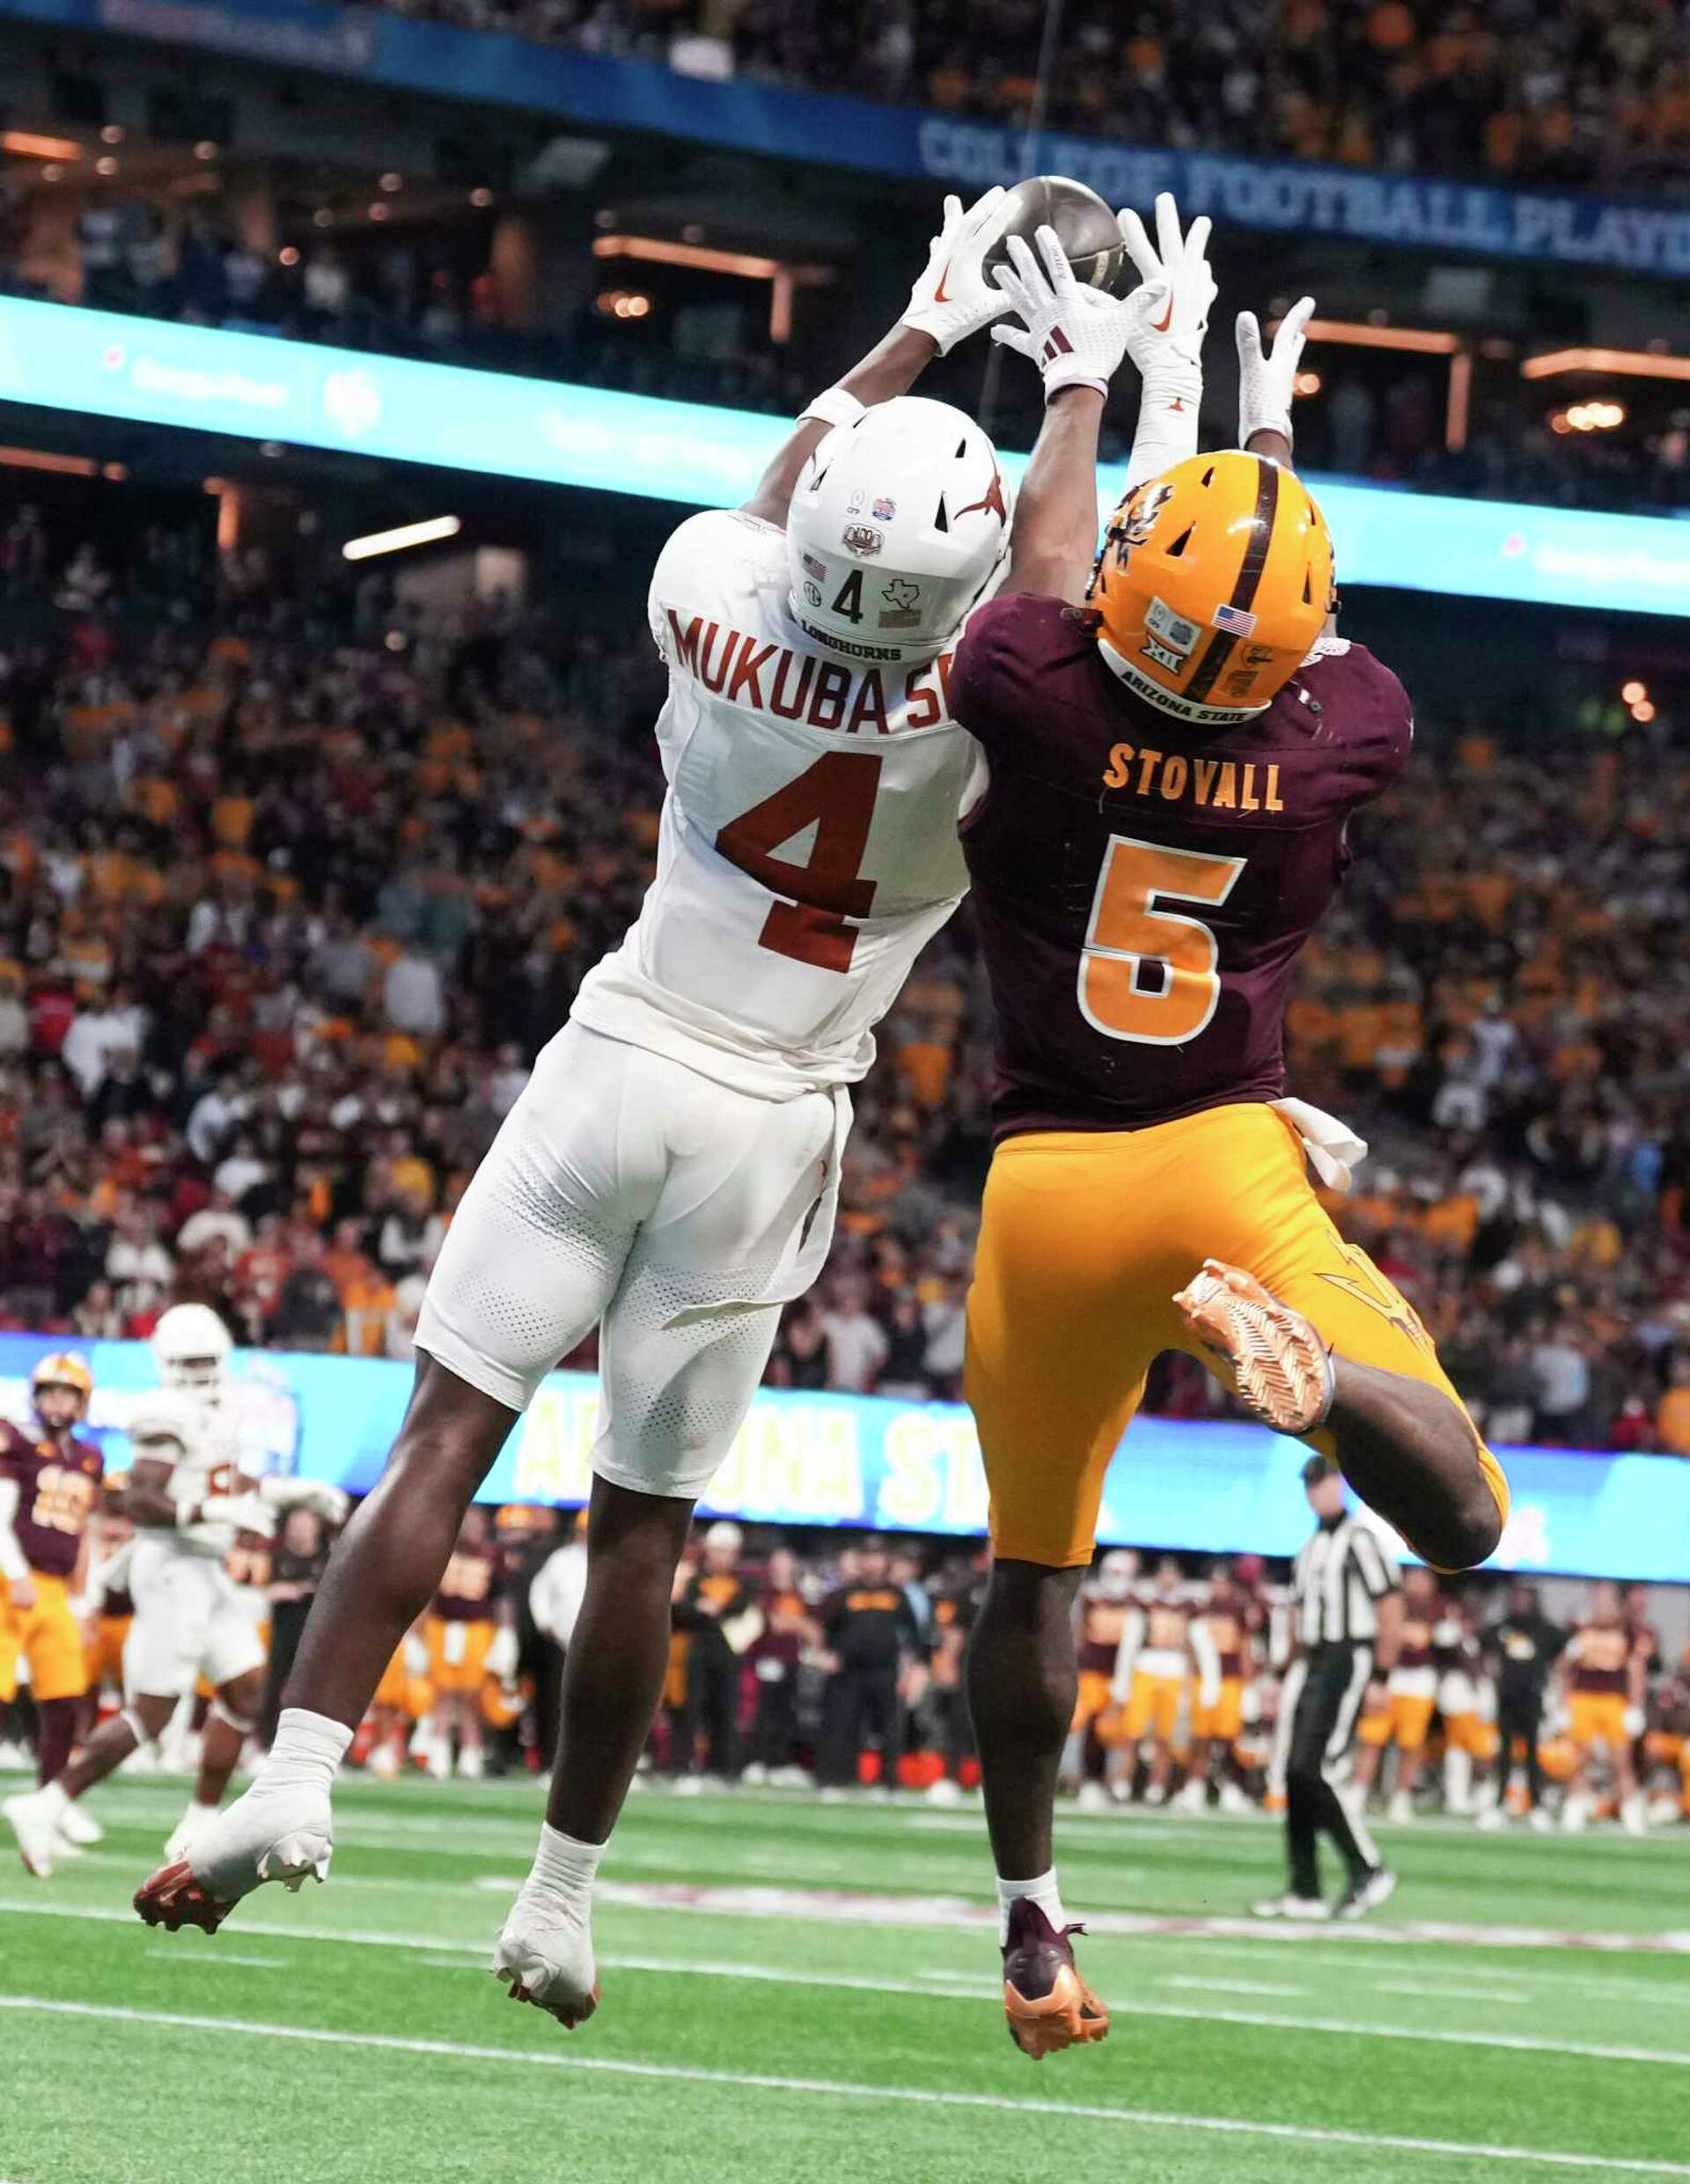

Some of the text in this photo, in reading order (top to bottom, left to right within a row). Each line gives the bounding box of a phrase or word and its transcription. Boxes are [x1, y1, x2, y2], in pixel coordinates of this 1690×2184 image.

[1187, 155, 1504, 249] FOOTBALL
[832, 569, 863, 624] 4
[667, 608, 890, 734] MUKUBA
[801, 619, 901, 661] LONGHORNS
[1121, 671, 1247, 722] ARIZONA STATE
[1102, 742, 1284, 812] STOVALL
[716, 751, 883, 973] 4
[1076, 833, 1249, 1046] 5
